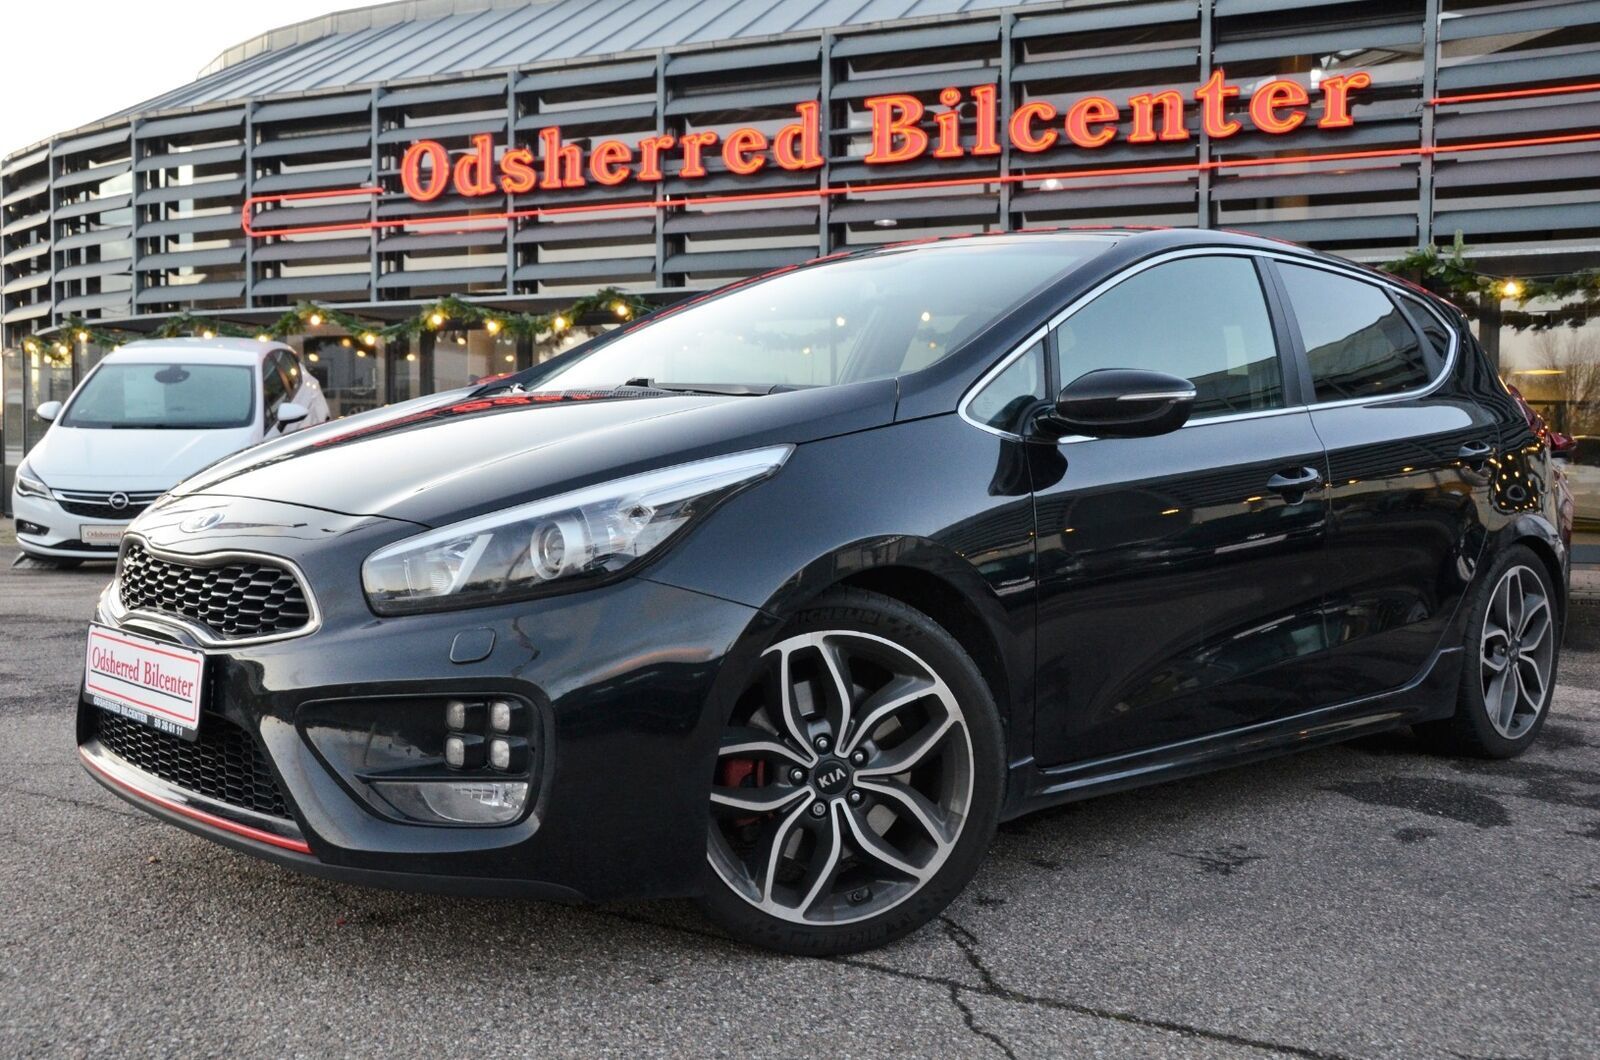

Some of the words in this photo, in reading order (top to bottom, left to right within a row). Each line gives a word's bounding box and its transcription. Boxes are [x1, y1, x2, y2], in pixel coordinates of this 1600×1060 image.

[400, 99, 825, 202] Odsherred
[863, 67, 1372, 165] Bilcenter
[92, 646, 140, 682] Odsherred
[143, 661, 194, 698] Bilcenter
[818, 768, 847, 788] KIA
